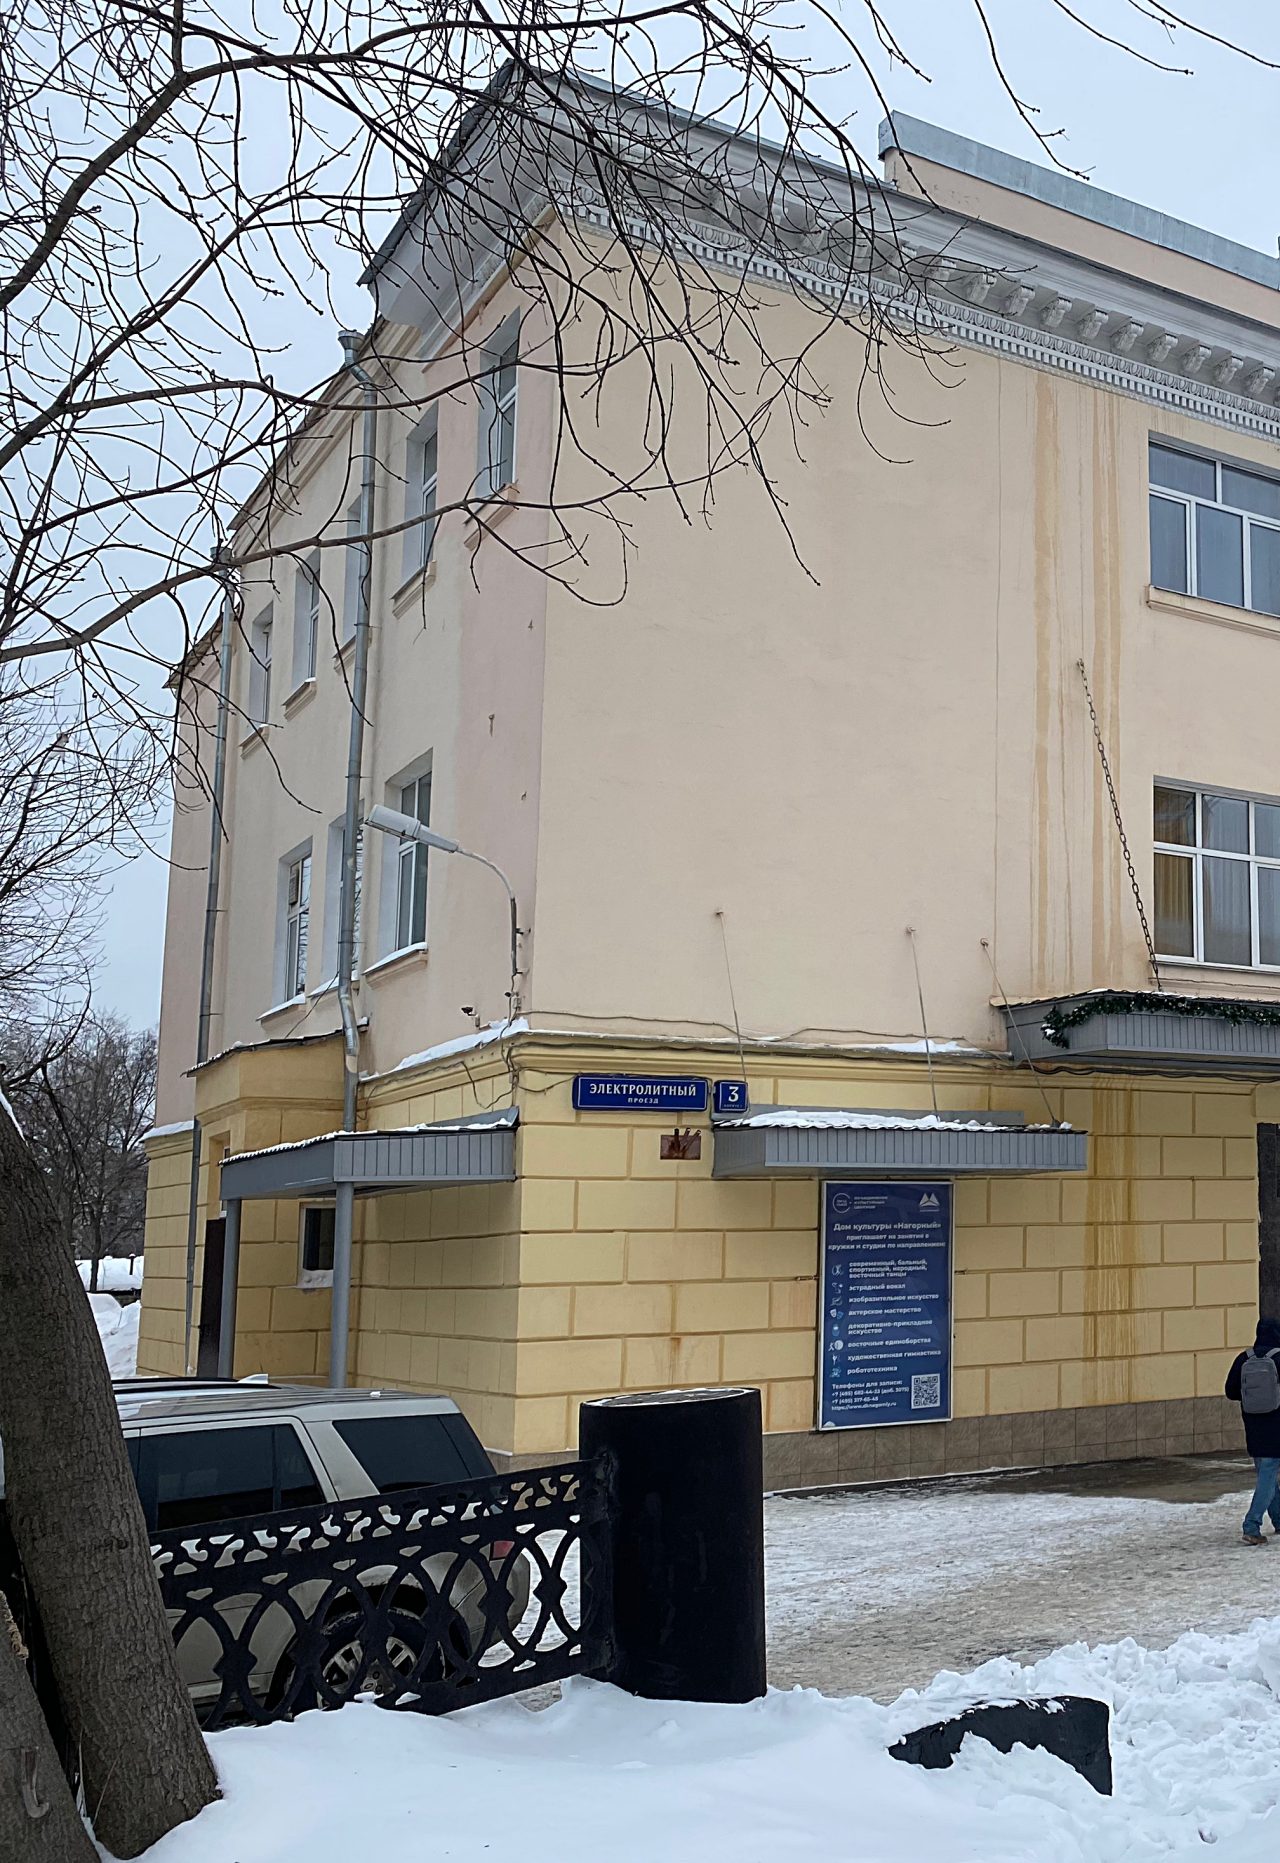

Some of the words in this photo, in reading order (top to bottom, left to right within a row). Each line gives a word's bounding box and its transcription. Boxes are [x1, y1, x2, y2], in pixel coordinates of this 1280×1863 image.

[589, 1083, 696, 1096] ЭЛЕКТРОЛИТНЫЙ
[728, 1086, 739, 1102] 3
[833, 1223, 852, 1231] Дом
[853, 1223, 892, 1232] культуры
[893, 1221, 941, 1230] «Нагорный»
[849, 1284, 885, 1292] эстрадный
[848, 1295, 906, 1303] изобразительное
[885, 1338, 931, 1346] единоборства
[848, 1353, 903, 1362] художественная
[847, 1366, 898, 1375] робототехника
